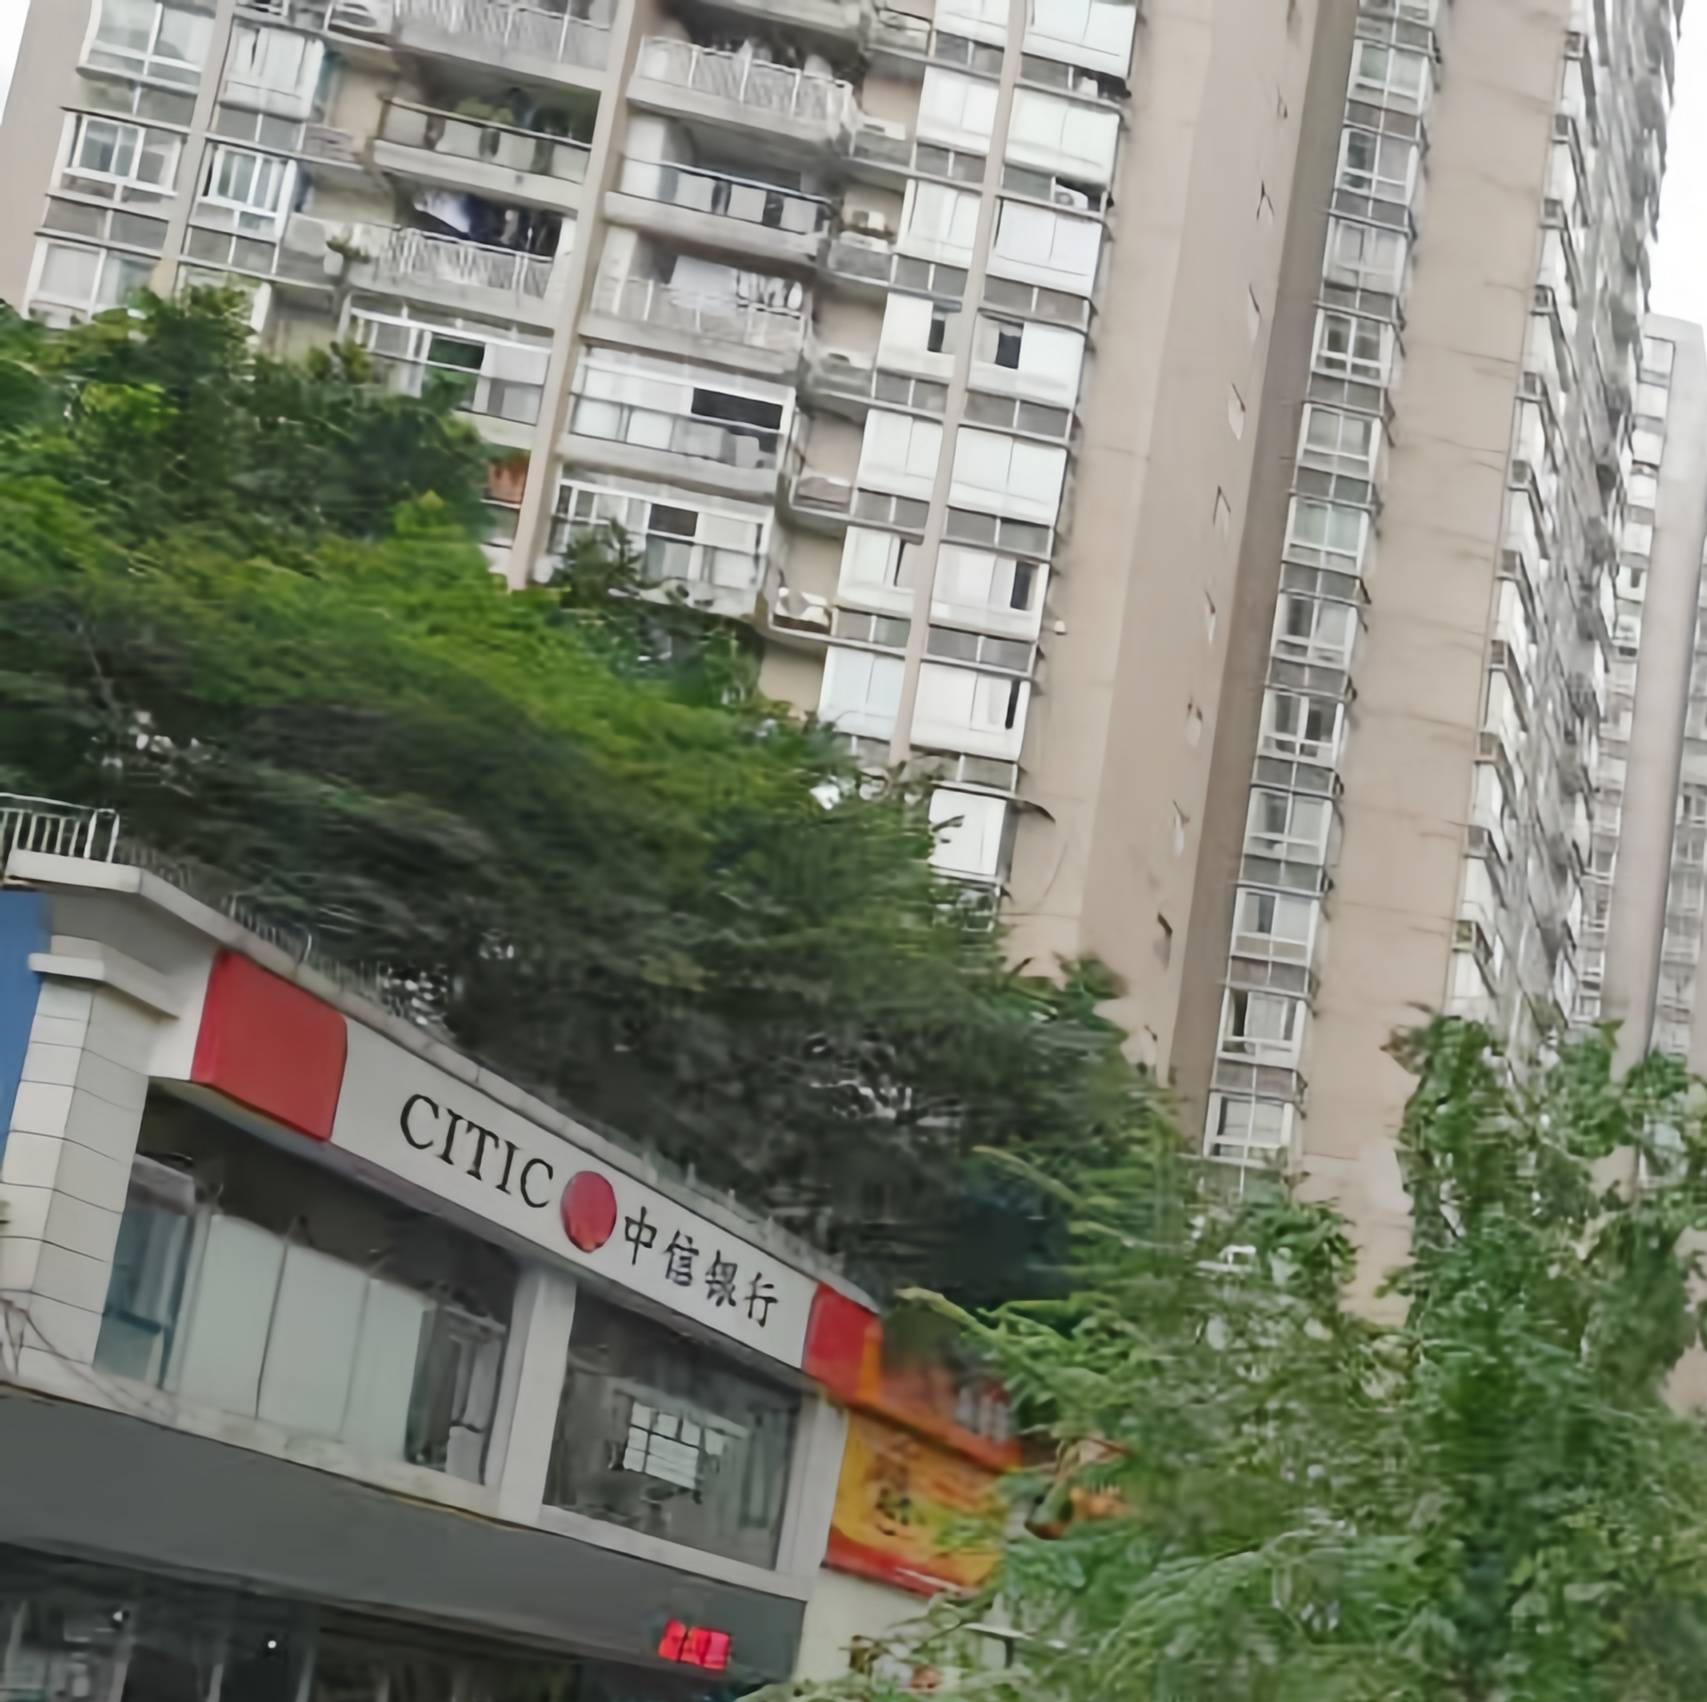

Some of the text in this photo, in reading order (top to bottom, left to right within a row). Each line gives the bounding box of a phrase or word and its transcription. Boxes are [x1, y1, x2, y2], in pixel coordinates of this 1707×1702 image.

[399, 1093, 556, 1210] CITIC
[624, 1206, 781, 1328] 中信银行
